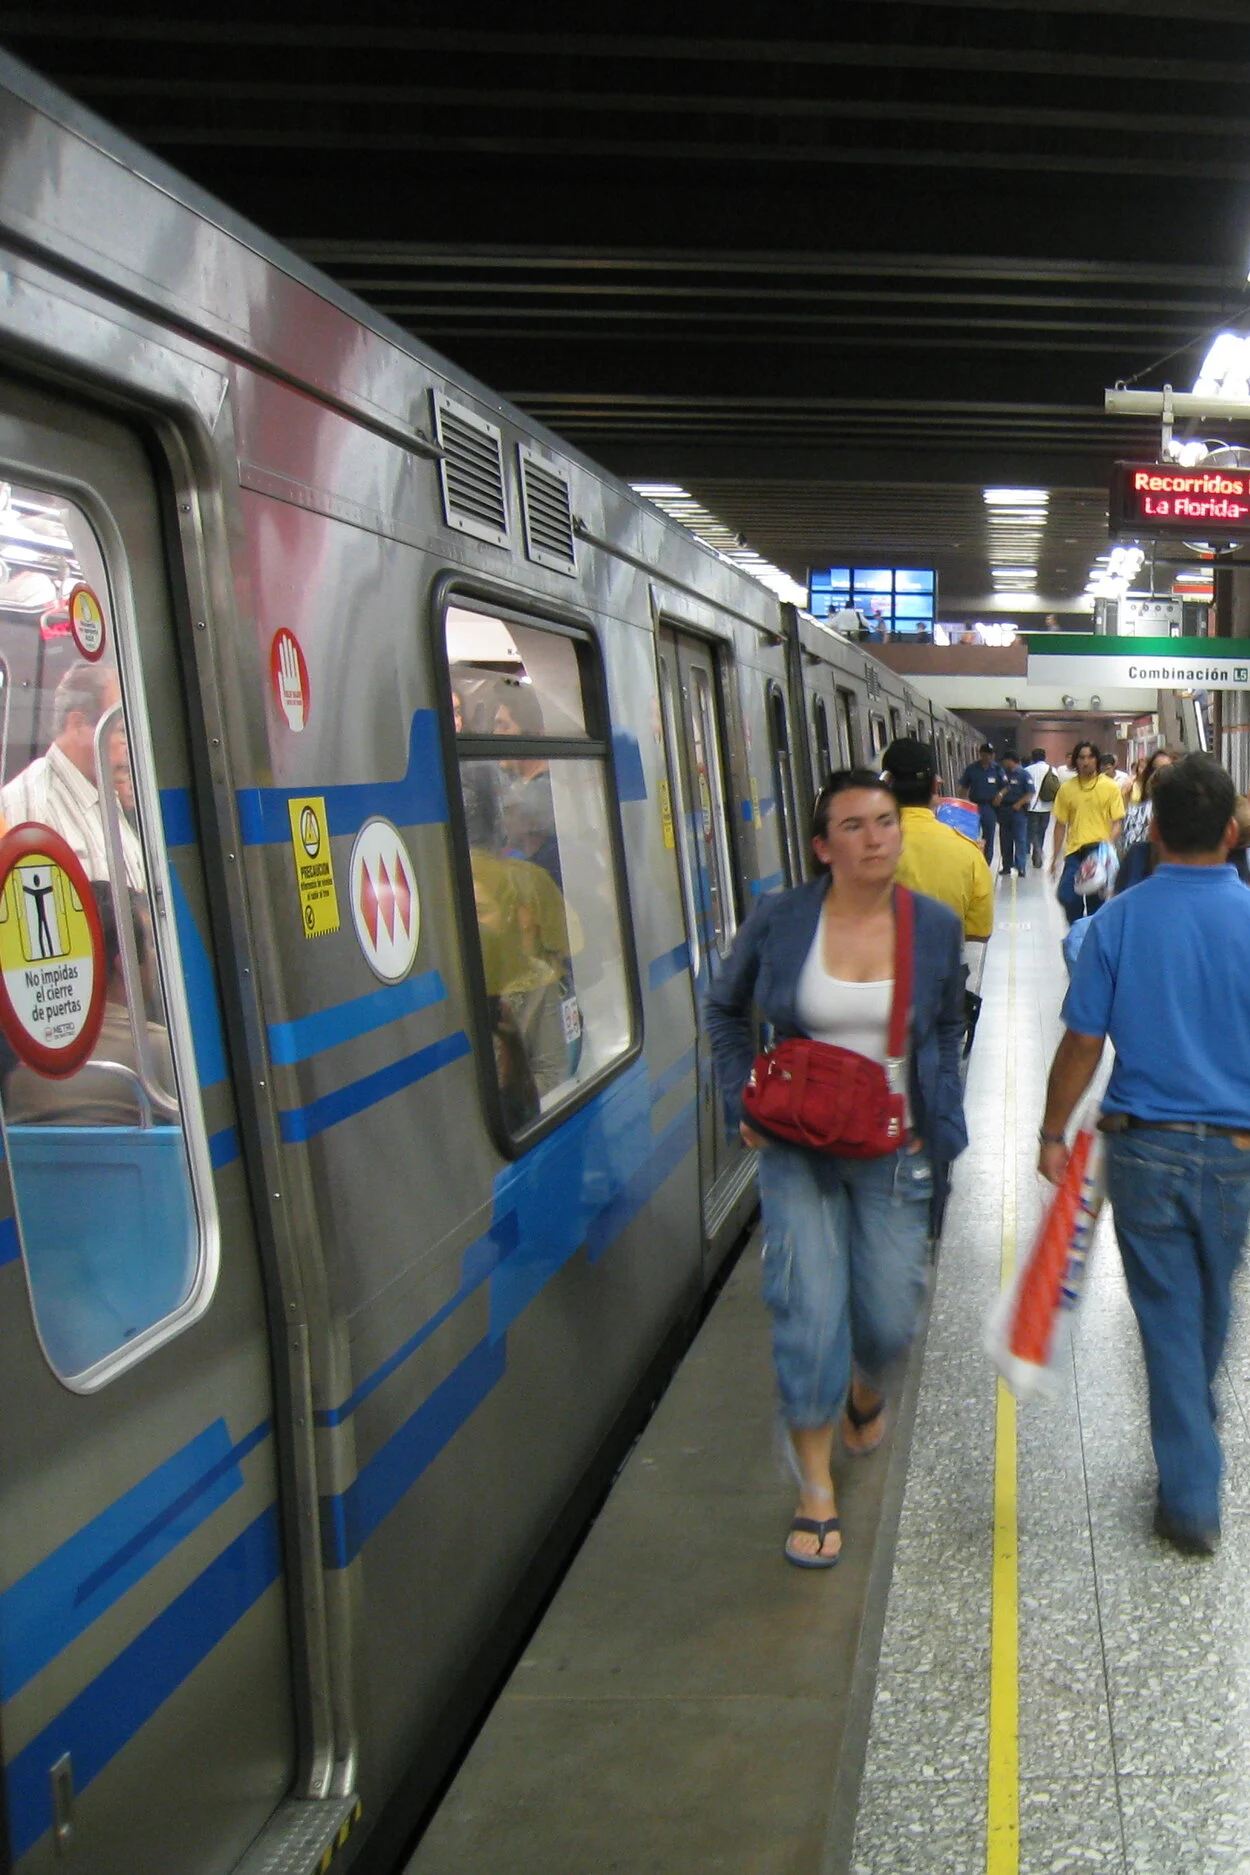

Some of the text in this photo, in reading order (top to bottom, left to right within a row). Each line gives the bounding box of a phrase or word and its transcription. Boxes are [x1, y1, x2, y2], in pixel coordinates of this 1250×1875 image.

[1134, 472, 1244, 495] Recorridos
[1144, 497, 1169, 515] La
[1128, 666, 1248, 681] Combinación L5
[25, 963, 79, 988] No impidas
[36, 984, 73, 1003] el cierre
[32, 999, 82, 1022] de puertas
[53, 1022, 75, 1033] METRO
